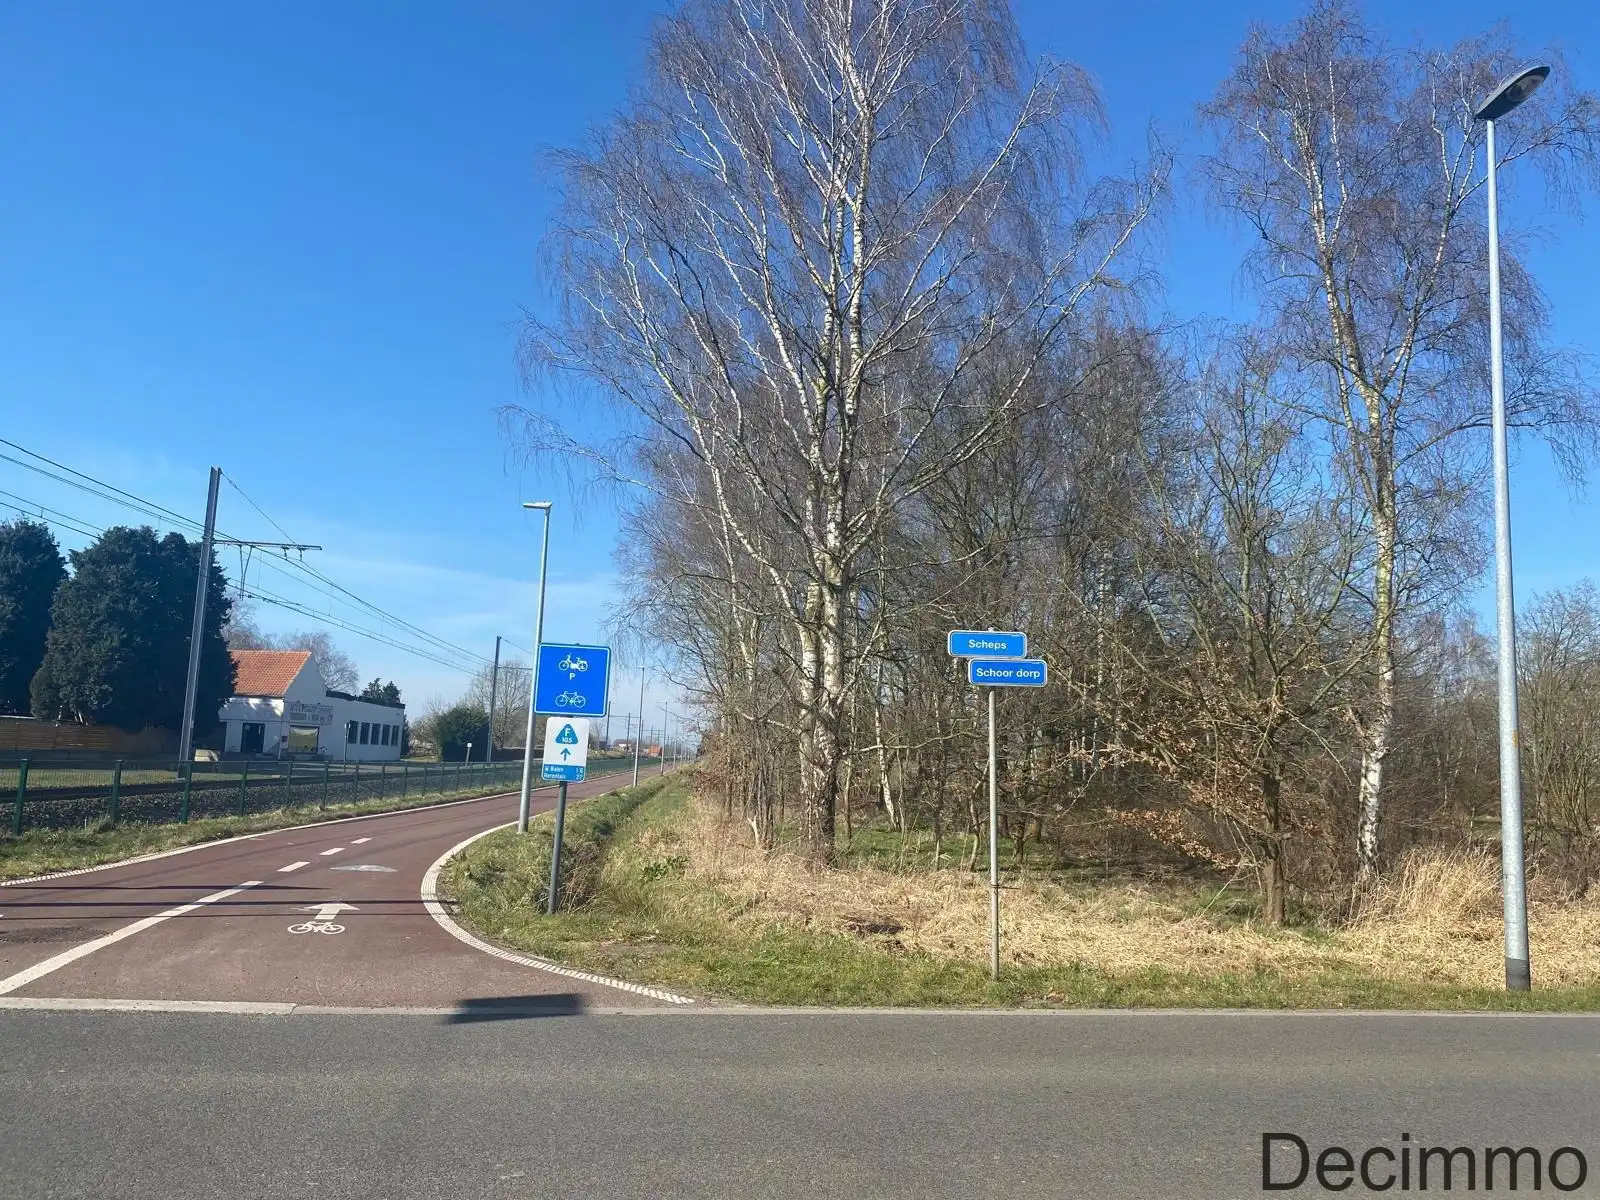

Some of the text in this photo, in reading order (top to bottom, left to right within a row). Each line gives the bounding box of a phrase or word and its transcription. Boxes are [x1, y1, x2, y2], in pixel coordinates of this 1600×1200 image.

[968, 639, 1007, 651] Scheps
[569, 673, 576, 681] P
[976, 668, 1041, 680] Schoor dorp
[565, 728, 571, 737] F
